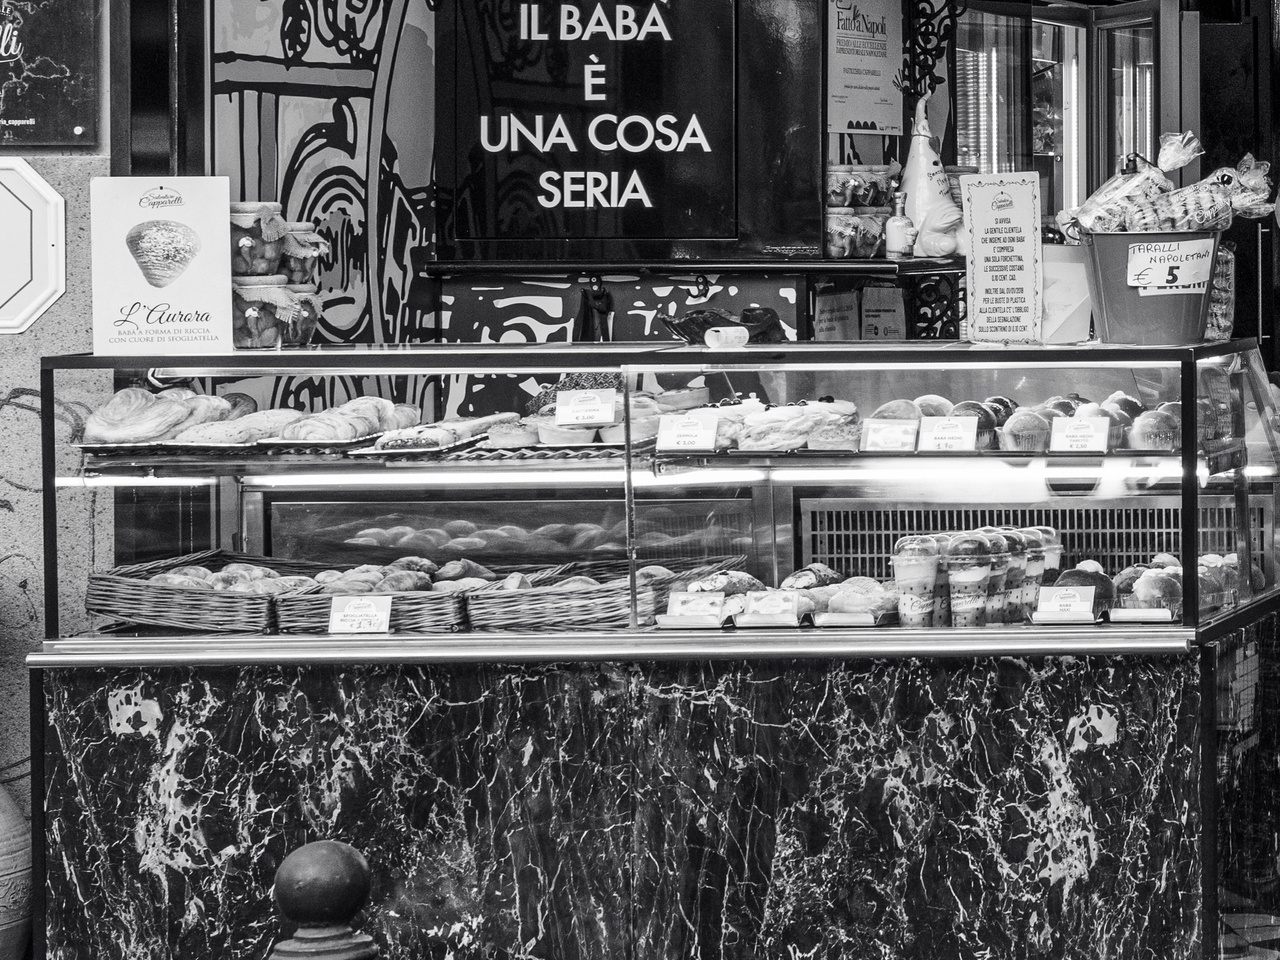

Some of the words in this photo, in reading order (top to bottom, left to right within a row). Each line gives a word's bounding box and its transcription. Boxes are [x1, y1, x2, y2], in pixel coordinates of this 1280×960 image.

[520, 3, 549, 40] IL
[584, 54, 606, 101] È
[480, 114, 578, 153] UNA
[588, 113, 712, 153] COSA
[537, 169, 653, 208] SERIA
[139, 196, 186, 208] Capparelli
[1129, 243, 1180, 255] TARALLI
[1149, 249, 1210, 264] NAPOLETANI
[1133, 268, 1153, 285] €
[1165, 265, 1180, 284] 5
[167, 335, 219, 343] SFOGLIATELLA
